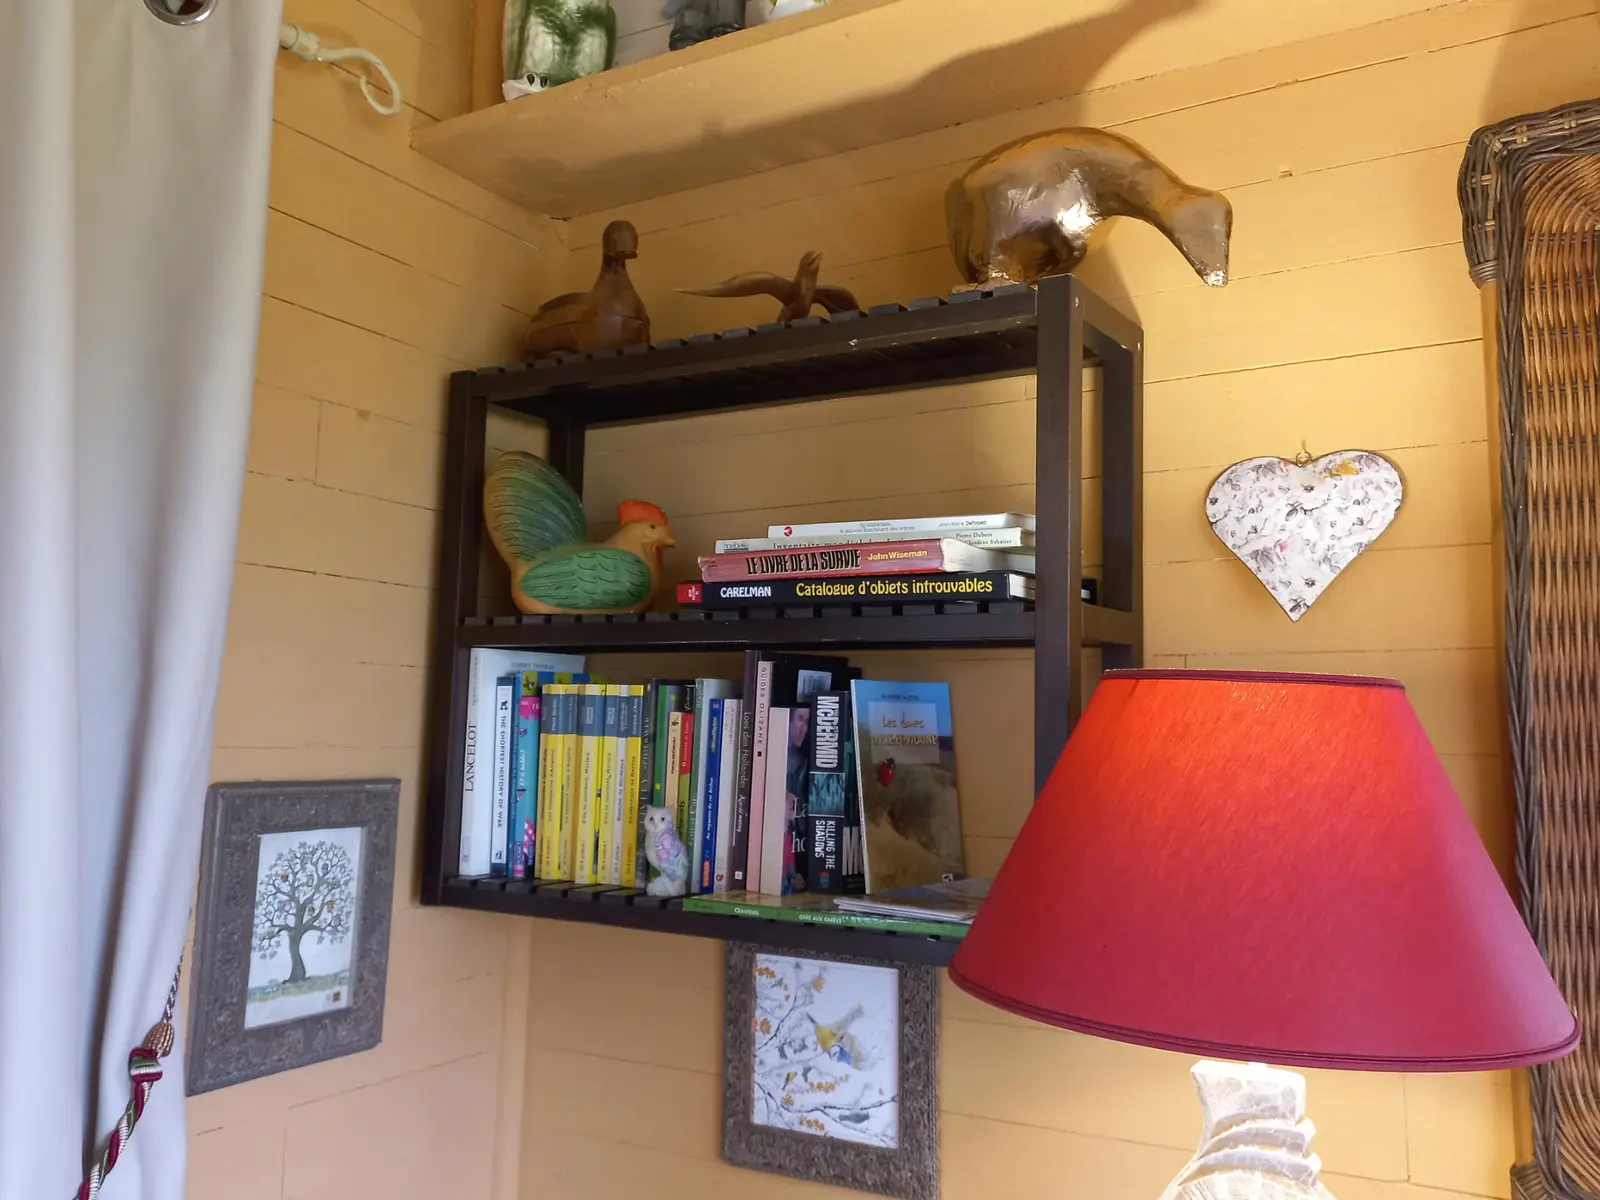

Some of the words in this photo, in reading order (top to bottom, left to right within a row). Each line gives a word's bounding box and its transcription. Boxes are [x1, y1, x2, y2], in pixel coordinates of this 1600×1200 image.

[747, 556, 760, 575] LE
[760, 553, 790, 574] LIVRE
[790, 552, 806, 572] DE
[805, 551, 820, 572] LA
[820, 548, 862, 570] SURVIE
[867, 552, 889, 562] John
[888, 549, 928, 560] Wiseman
[720, 584, 772, 598] CARELMAN
[796, 580, 856, 597] Catalogue
[860, 578, 909, 597] d'objets
[912, 578, 994, 595] introuvables
[743, 712, 752, 730] Loes
[757, 702, 765, 745] OLIZANE
[498, 730, 506, 766] SHORTEST
[742, 732, 751, 747] den
[464, 722, 479, 792] LANCELOT
[740, 748, 750, 789] Hollander
[497, 798, 504, 810] OF
[496, 811, 504, 828] WAR
[814, 820, 826, 858] SHADOWS
[826, 820, 836, 852] KILLING
[825, 854, 836, 870] THE
